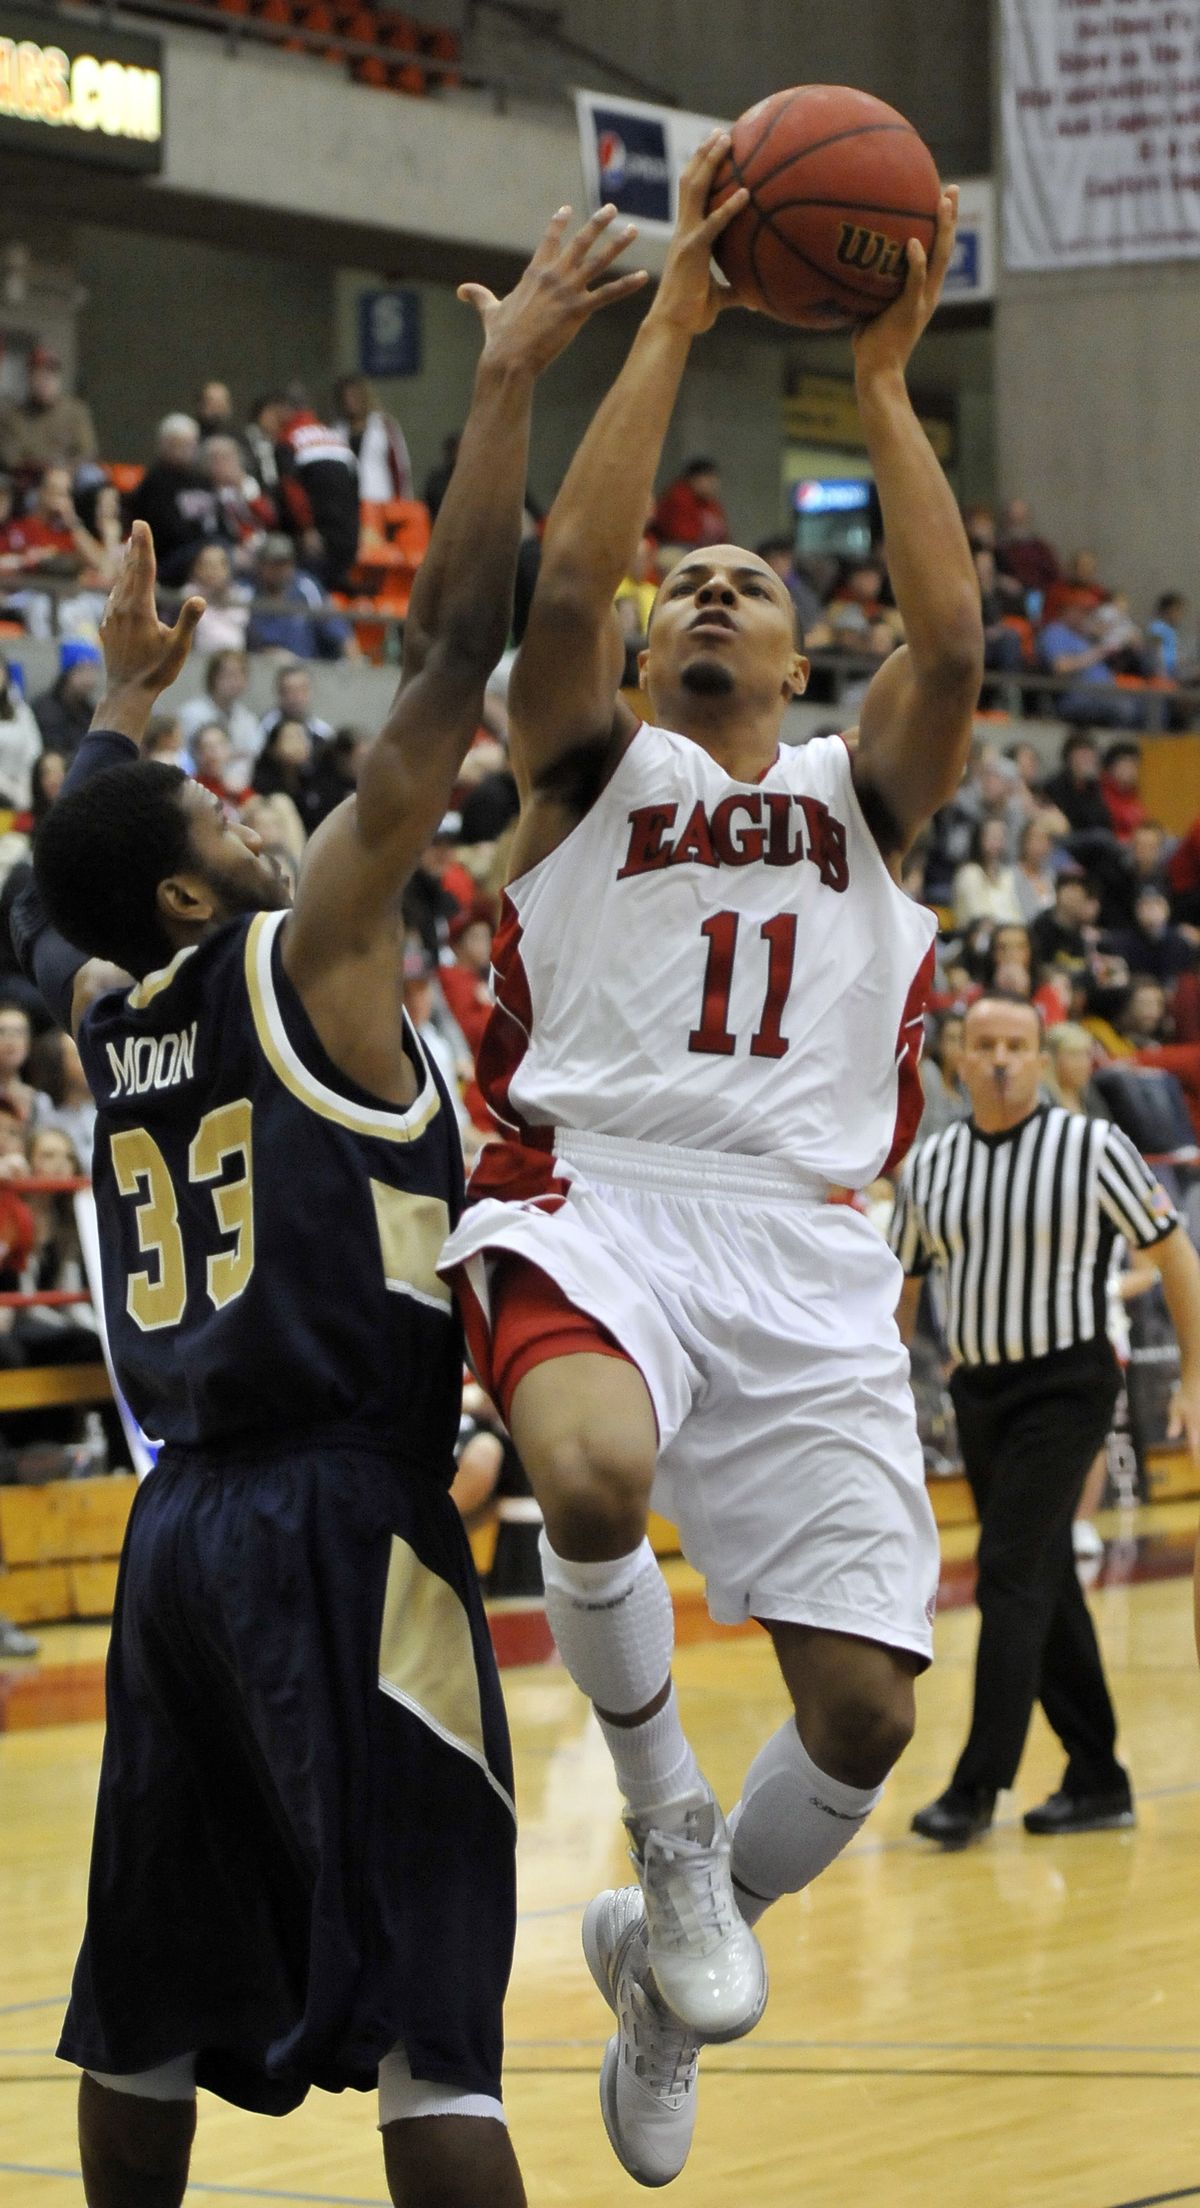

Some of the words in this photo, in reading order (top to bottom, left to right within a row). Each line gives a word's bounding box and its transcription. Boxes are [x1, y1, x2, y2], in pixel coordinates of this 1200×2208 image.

[838, 221, 910, 277] Wil
[688, 910, 798, 1060] 11
[106, 1021, 198, 1098] MOON
[110, 1097, 254, 1332] 33
